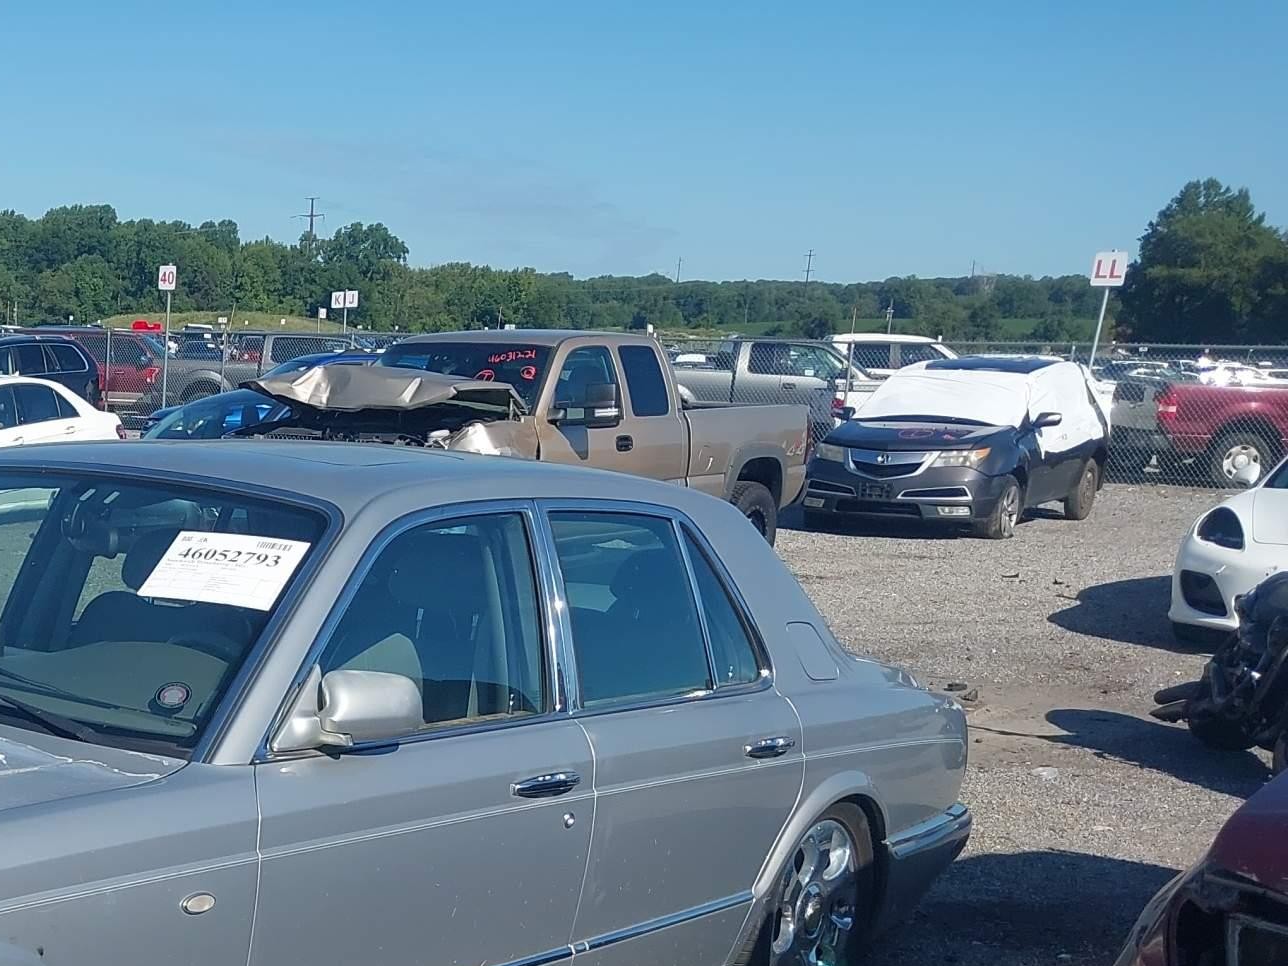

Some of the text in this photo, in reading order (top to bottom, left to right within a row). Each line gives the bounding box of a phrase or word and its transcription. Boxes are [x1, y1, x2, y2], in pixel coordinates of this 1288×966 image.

[1095, 259, 1122, 279] LL
[160, 271, 174, 285] 40
[334, 294, 342, 306] K
[348, 293, 355, 305] J
[177, 547, 282, 568] 46052793
